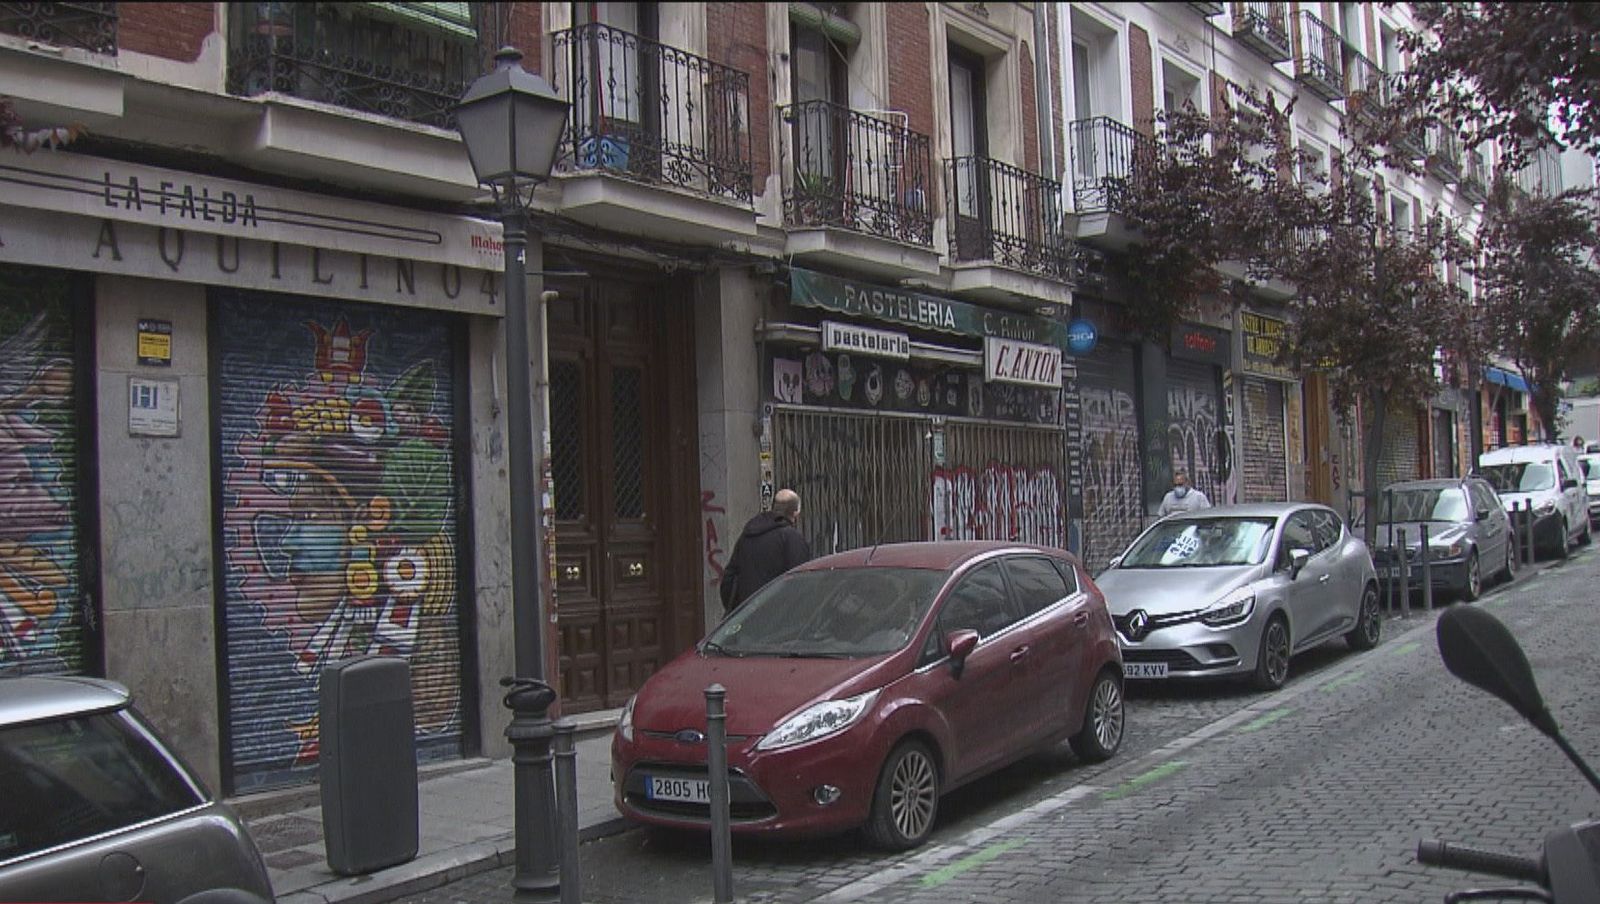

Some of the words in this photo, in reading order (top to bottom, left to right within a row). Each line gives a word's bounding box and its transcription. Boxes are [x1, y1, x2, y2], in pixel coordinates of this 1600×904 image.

[103, 172, 142, 211] LA
[159, 181, 259, 228] FALDA
[92, 219, 462, 300] AQUILINO
[844, 285, 956, 329] PASTELERIA
[1143, 664, 1165, 677] KVV
[655, 779, 691, 798] 2805
